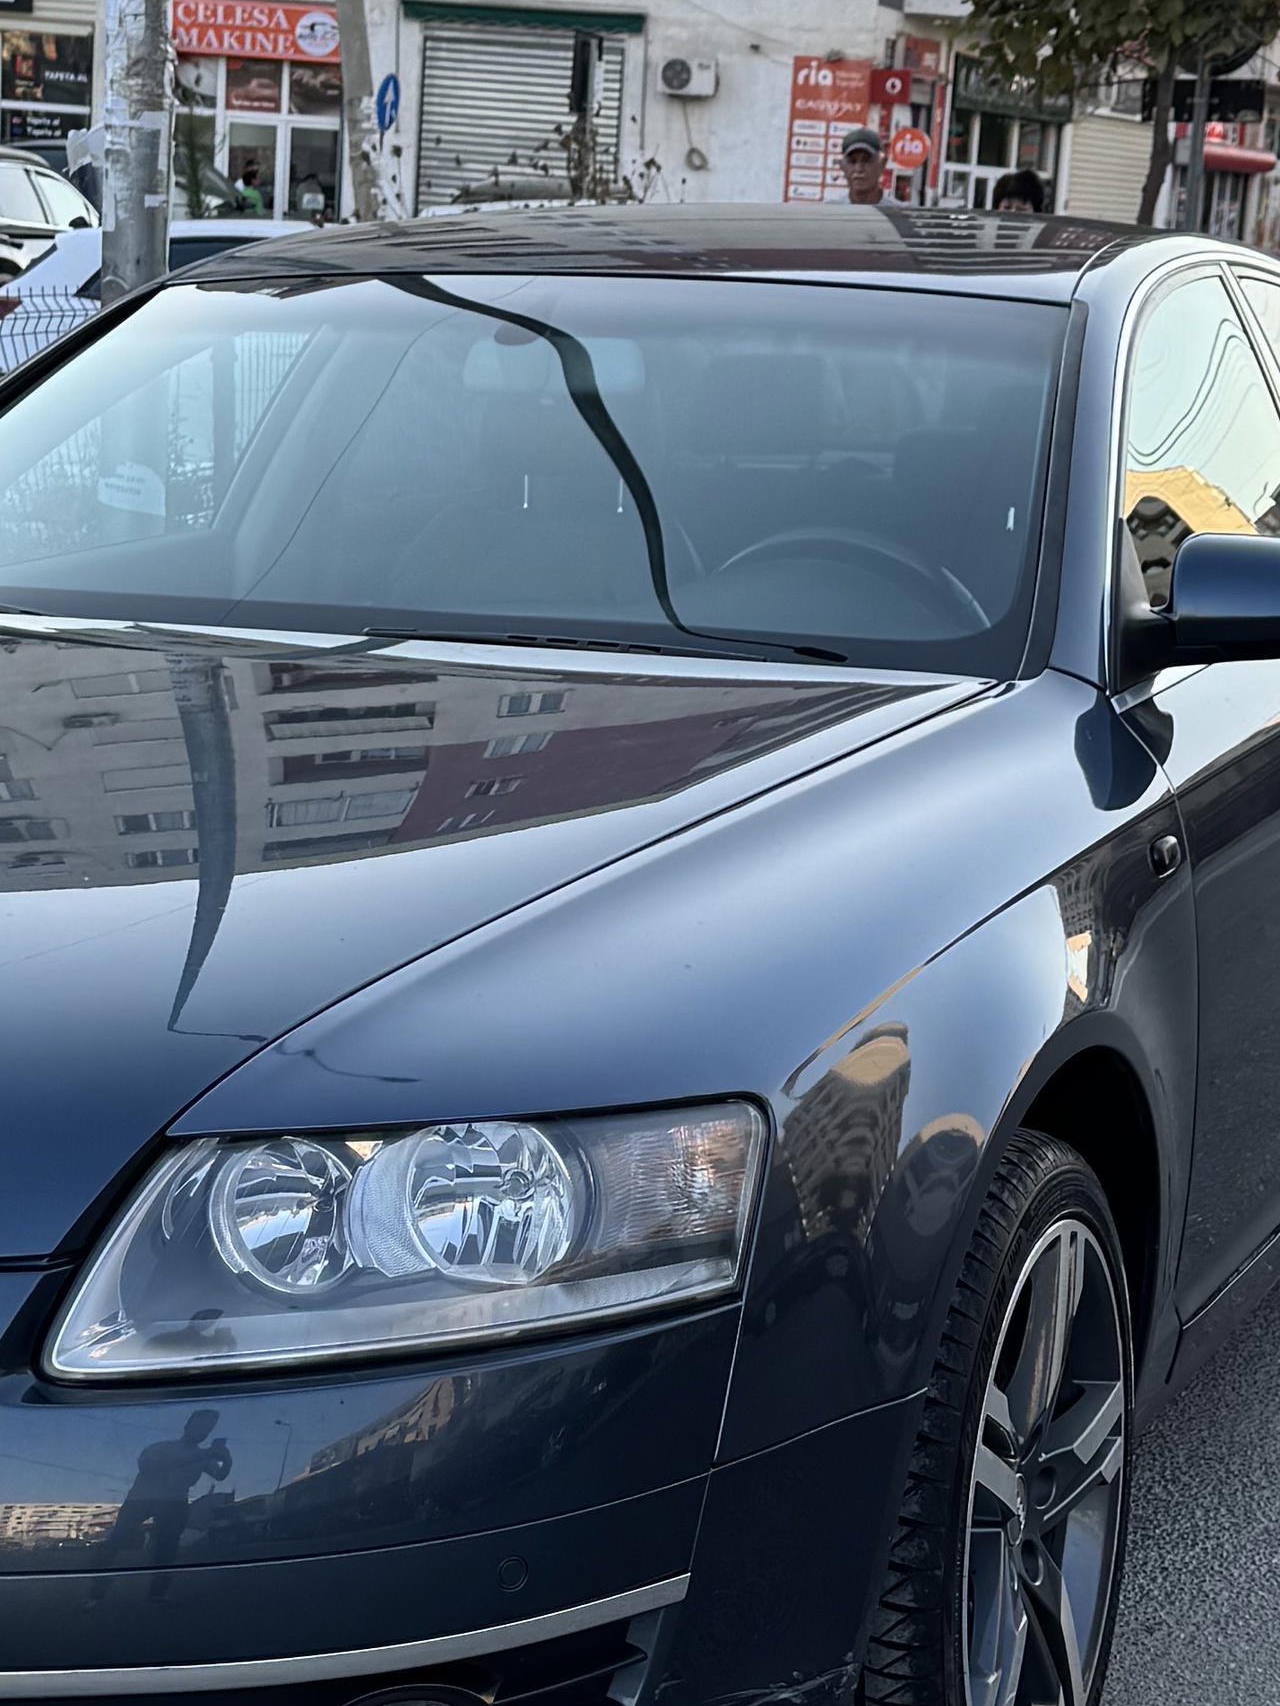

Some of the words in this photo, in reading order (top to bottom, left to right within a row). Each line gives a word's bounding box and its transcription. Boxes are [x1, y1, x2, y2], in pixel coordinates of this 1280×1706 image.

[175, 27, 295, 55] MAKINE
[797, 60, 834, 86] ria
[894, 133, 923, 154] ria
